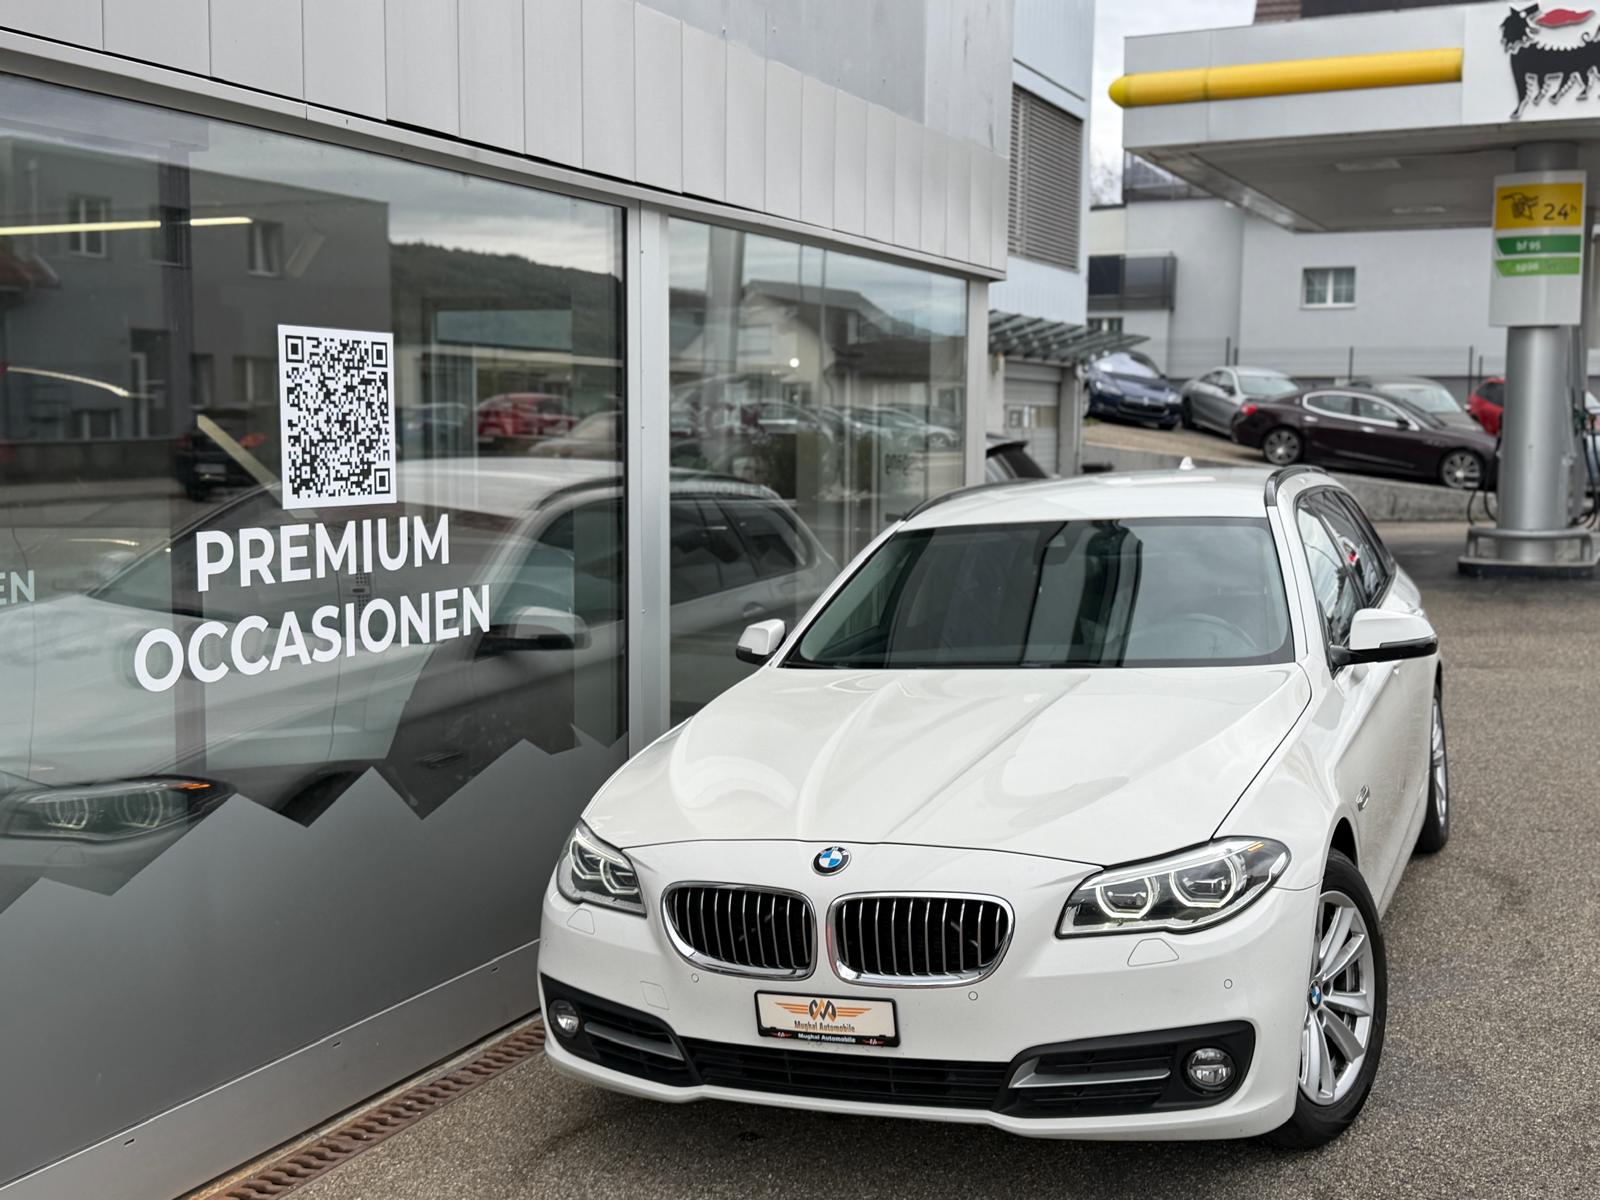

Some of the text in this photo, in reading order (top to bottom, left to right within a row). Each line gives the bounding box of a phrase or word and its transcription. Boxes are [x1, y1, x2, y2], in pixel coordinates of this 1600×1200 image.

[196, 513, 450, 592] PREMIUM
[134, 584, 491, 692] OCCASIONEN
[794, 1020, 855, 1032] Mughal Automobile
[798, 1033, 856, 1043] Mughal Automobile
